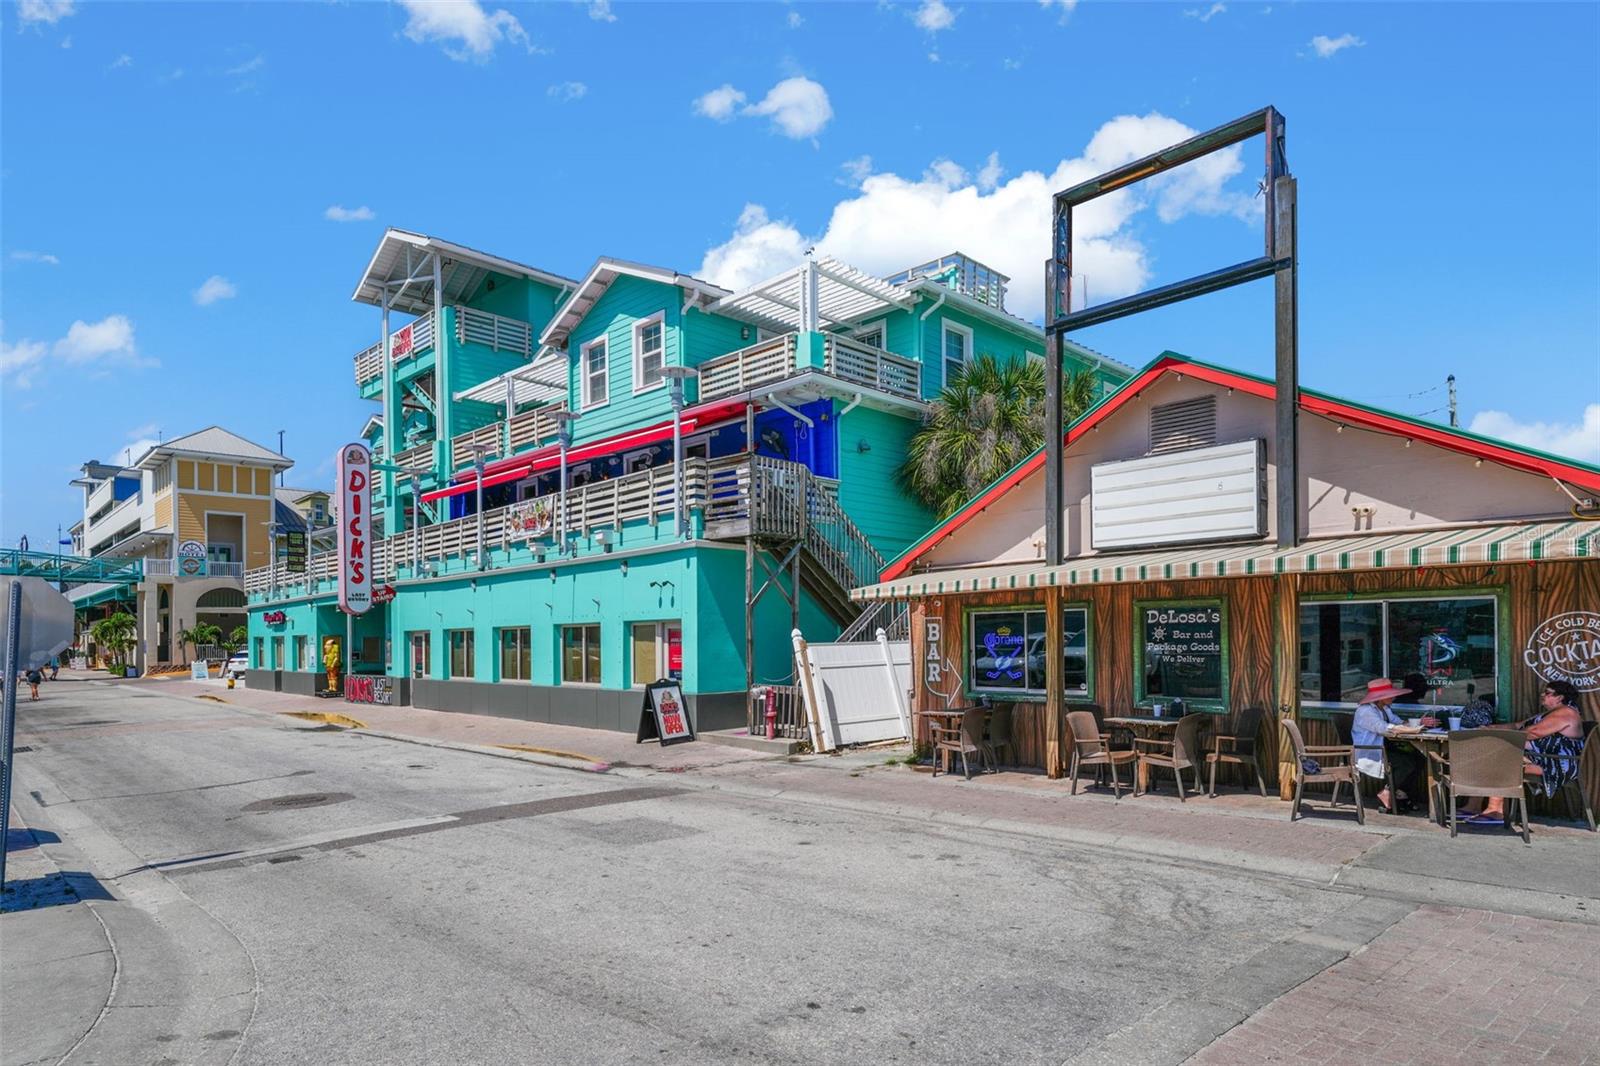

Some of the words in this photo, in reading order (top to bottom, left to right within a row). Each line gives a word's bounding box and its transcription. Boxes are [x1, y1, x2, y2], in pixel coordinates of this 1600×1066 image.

[348, 469, 366, 585] DICK'S
[1147, 609, 1220, 623] DeLosa's
[1172, 630, 1191, 639] Bar
[1193, 630, 1213, 639] and
[1536, 627, 1556, 645] ICE
[1555, 617, 1584, 630] COLD
[984, 632, 1025, 649] Corona
[927, 623, 941, 682] BAR
[1147, 642, 1188, 654] Package
[1190, 642, 1220, 651] Goods
[1162, 655, 1175, 663] We
[1177, 655, 1205, 663] Deliver
[373, 677, 386, 690] LAST
[1543, 665, 1569, 682] NEW
[1570, 675, 1597, 688] YORK
[373, 690, 392, 705] RESORT
[663, 712, 682, 725] NOW
[664, 722, 684, 735] OPEN
